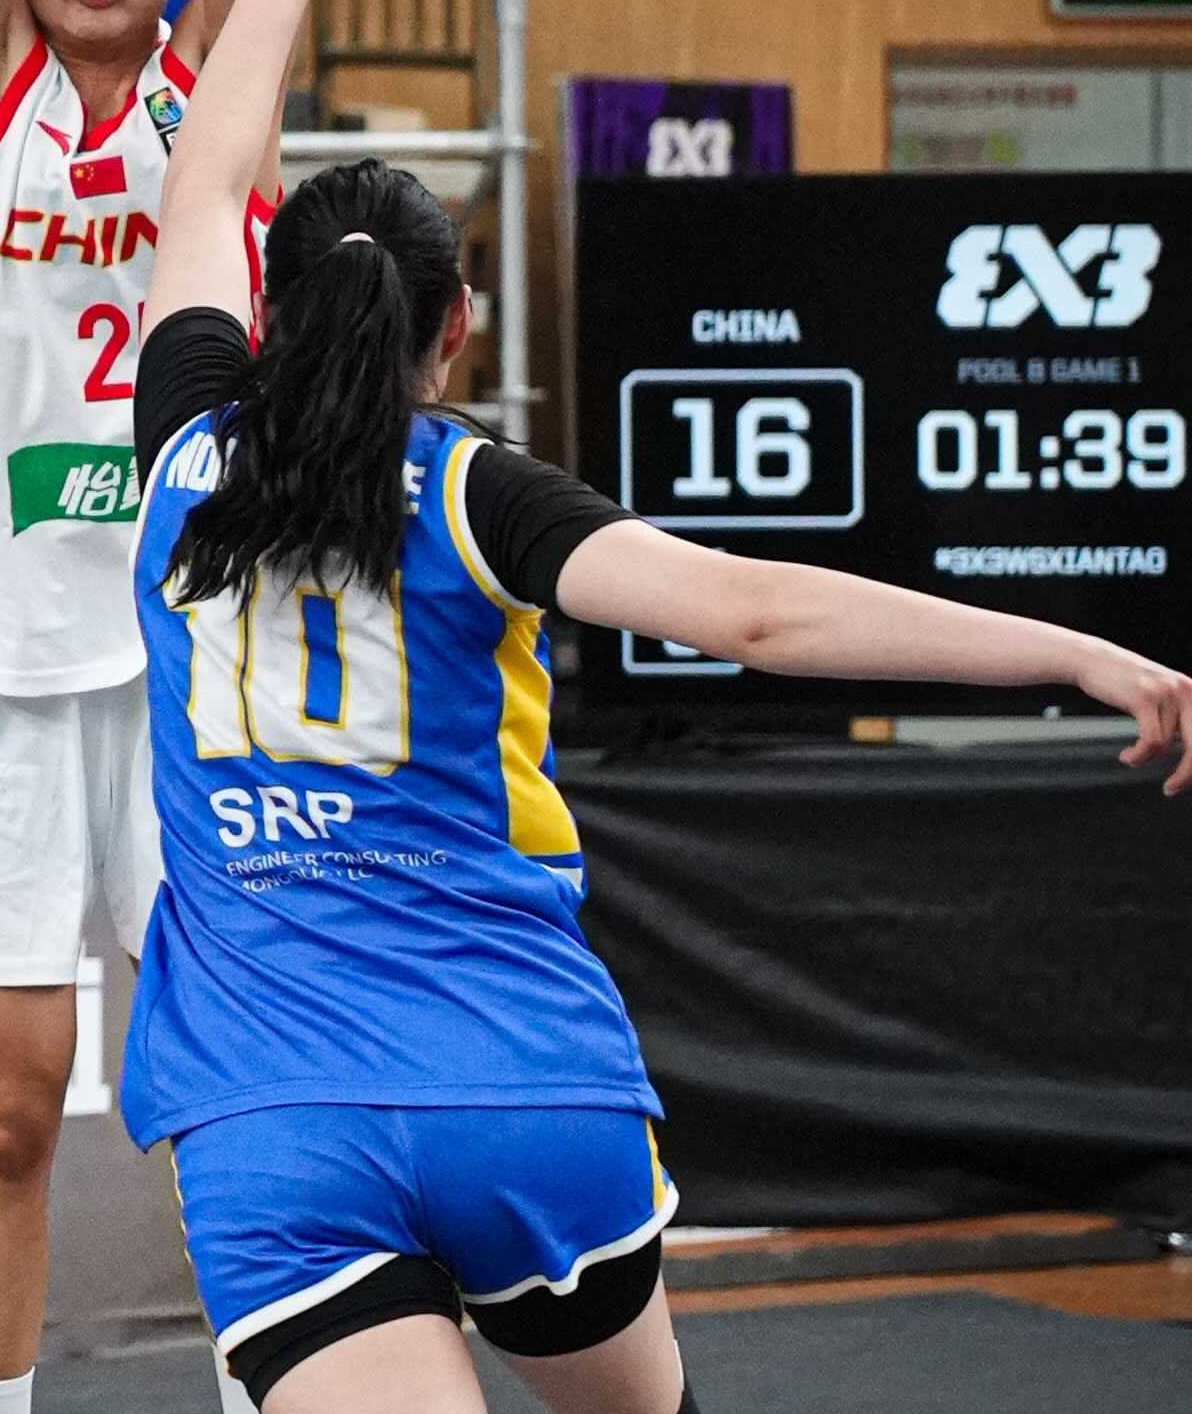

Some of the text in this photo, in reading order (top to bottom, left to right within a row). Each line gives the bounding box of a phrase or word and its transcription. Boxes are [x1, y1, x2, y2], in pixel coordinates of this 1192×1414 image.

[0, 208, 159, 267] CHIN
[77, 300, 145, 403] 2
[692, 308, 800, 343] CHINA
[958, 357, 1023, 384] POOL
[1050, 357, 1121, 384] GAME
[1127, 357, 1141, 384] 1
[672, 397, 811, 499] 16
[917, 409, 1187, 489] 01:39
[162, 555, 410, 775] 10
[209, 786, 354, 848] SRP
